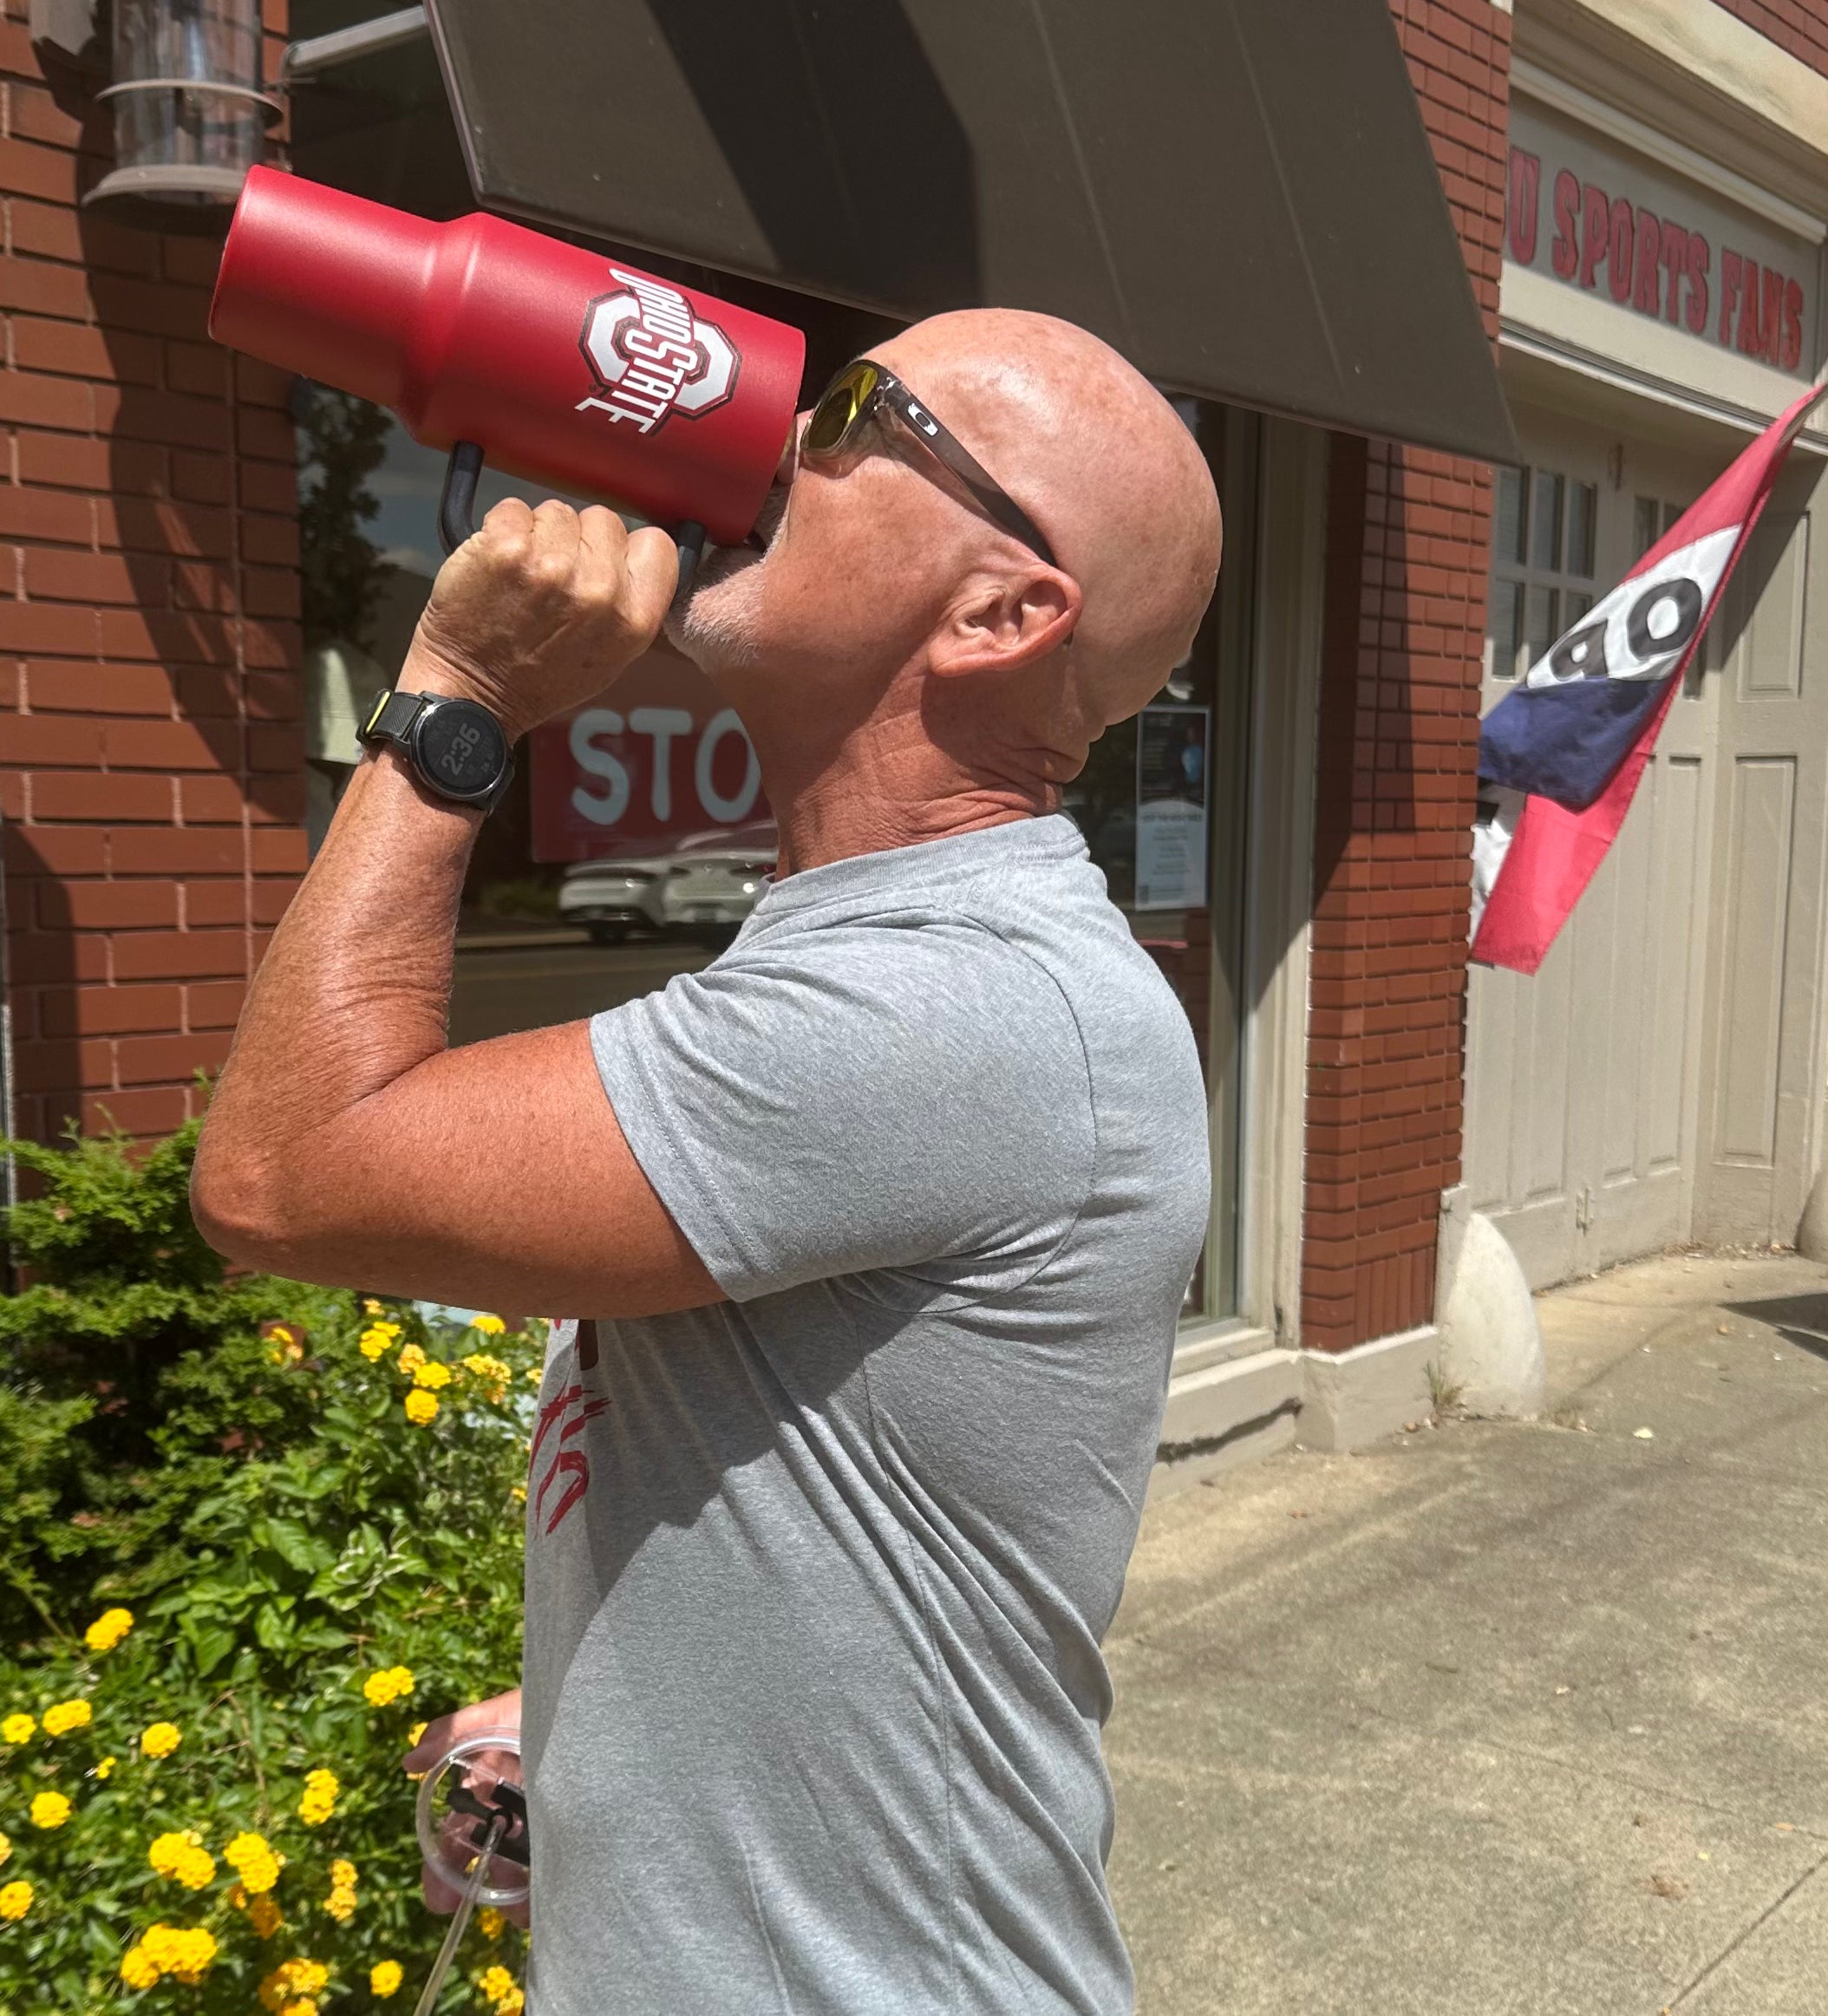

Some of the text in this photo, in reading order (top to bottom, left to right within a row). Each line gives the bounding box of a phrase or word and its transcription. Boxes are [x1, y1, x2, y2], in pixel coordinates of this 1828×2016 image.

[574, 268, 699, 434] OHIO STATE
[1551, 167, 1710, 335] SPORTS
[1718, 245, 1804, 371] FANS
[441, 722, 481, 776] 2:36
